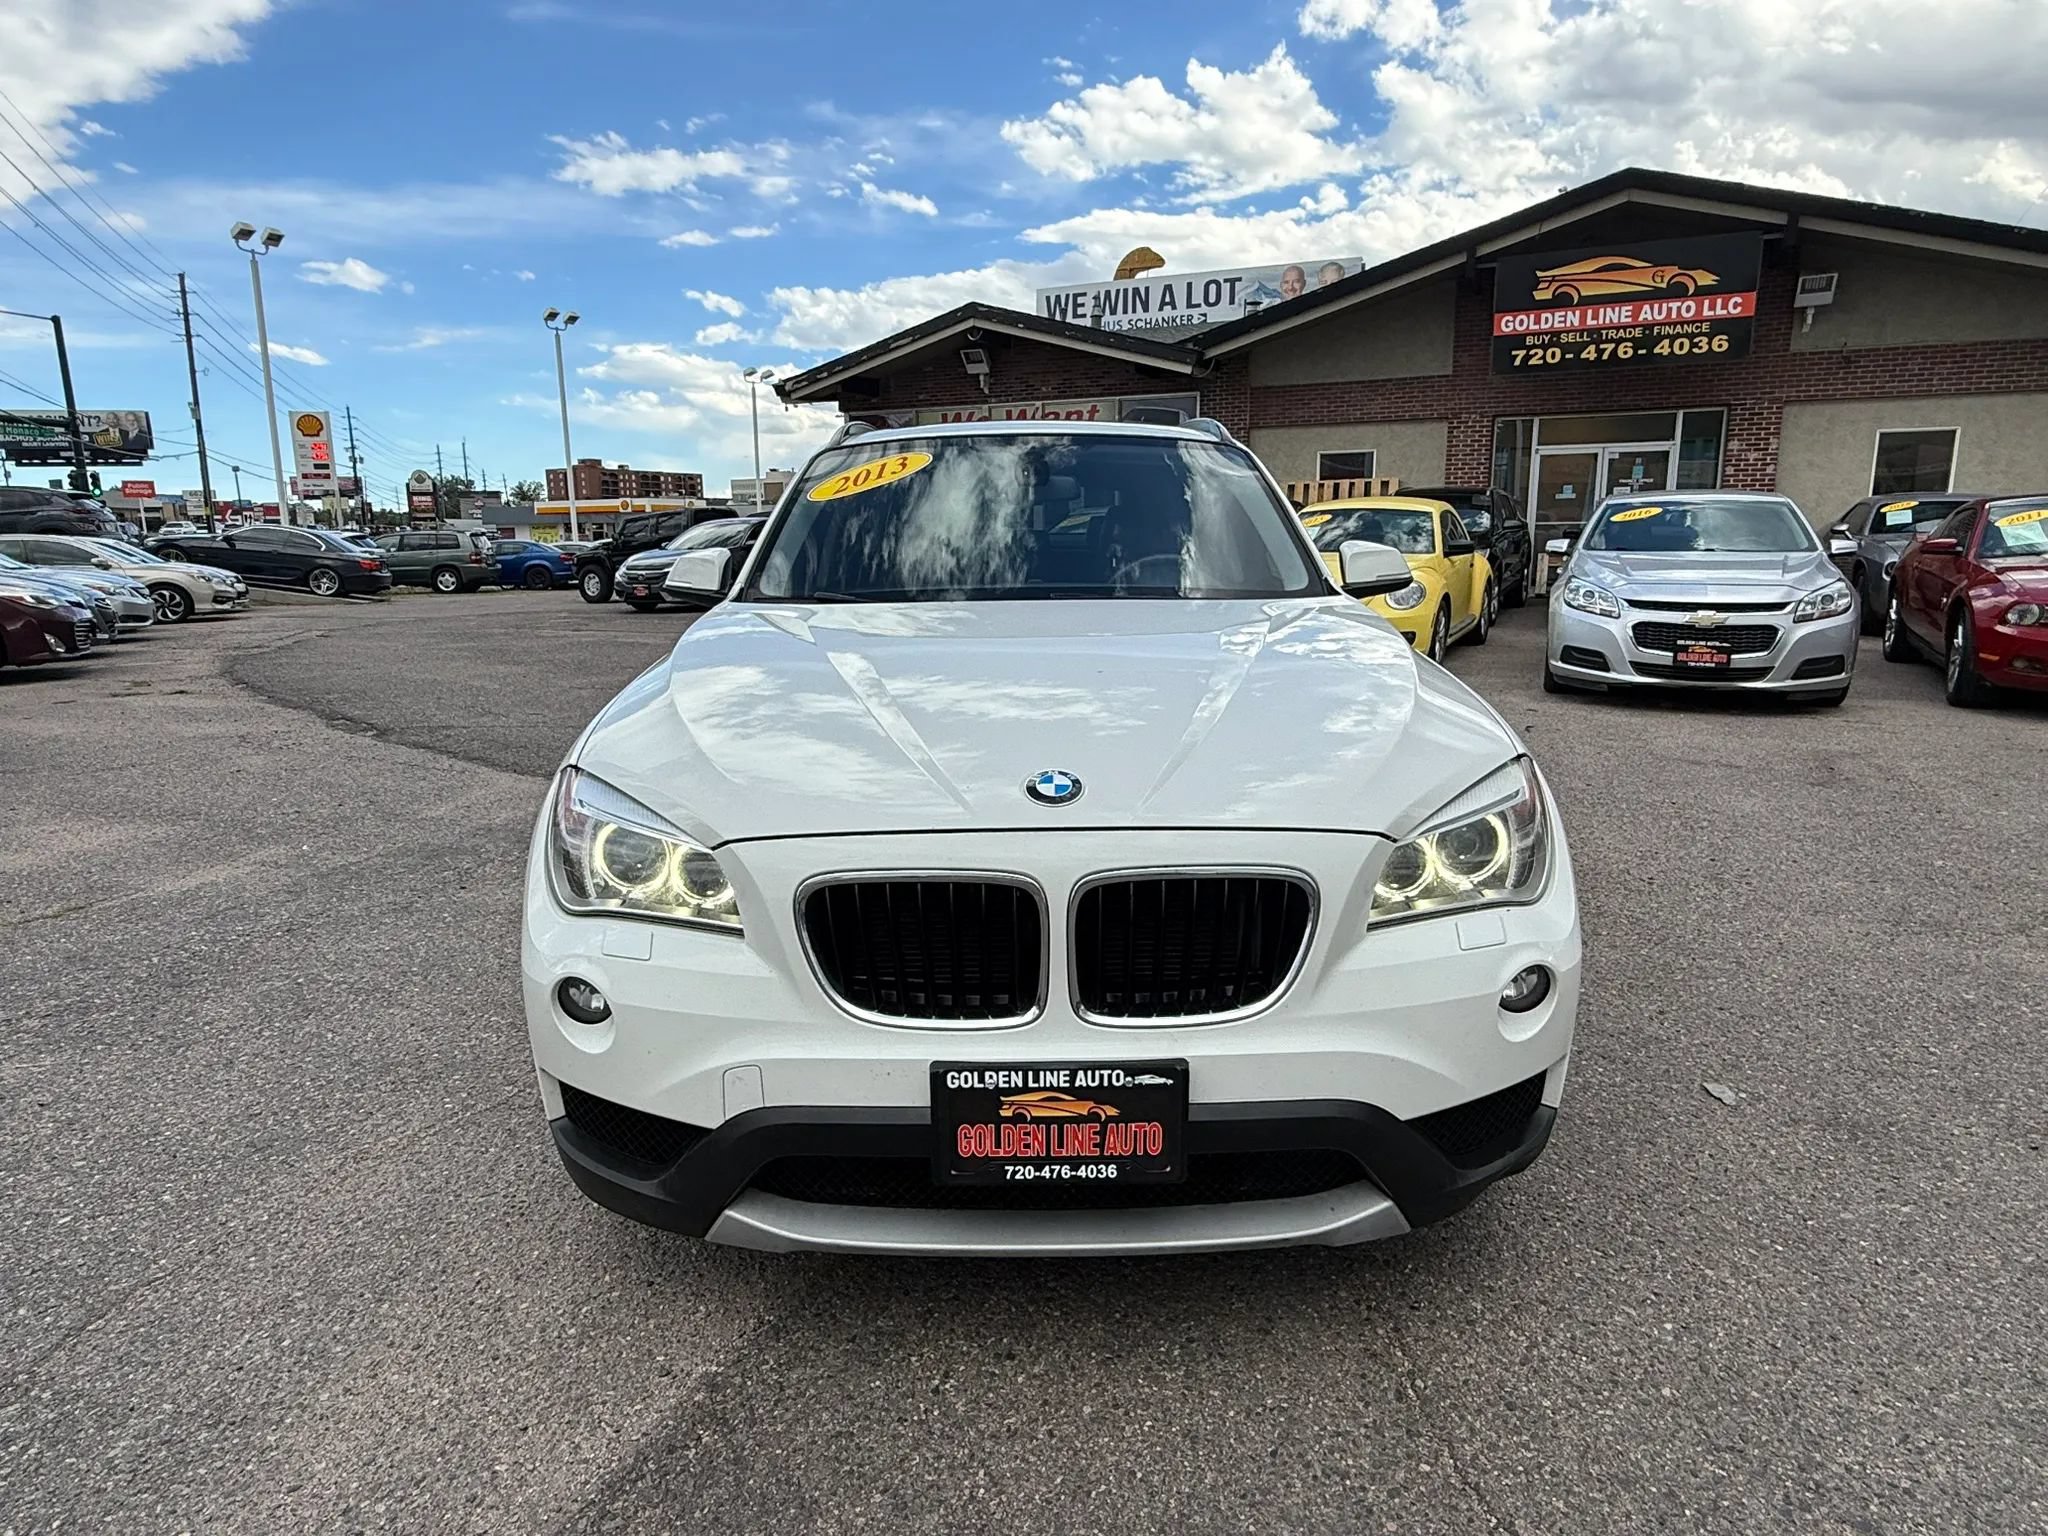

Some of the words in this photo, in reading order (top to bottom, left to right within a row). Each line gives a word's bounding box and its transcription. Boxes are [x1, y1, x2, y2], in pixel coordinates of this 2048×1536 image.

[1045, 291, 1088, 321] WE
[1097, 283, 1150, 317] WIN
[1157, 281, 1178, 311] A
[1185, 276, 1243, 310] LOT
[1127, 313, 1194, 330] SCHANKER
[1500, 311, 1581, 332] GOLDEN
[1586, 305, 1633, 326] LINE
[1638, 301, 1696, 321] AUTO
[1702, 296, 1743, 316] LLC
[1525, 334, 1551, 346] BUY
[1560, 332, 1591, 344] SELL
[1601, 328, 1643, 340] TRADE
[1653, 322, 1711, 337] FINANCE
[6, 426, 40, 436] Monaco
[832, 456, 909, 496] 2013
[2006, 511, 2042, 525] 2011
[946, 1070, 1023, 1089] GOLDEN
[1027, 1069, 1070, 1088] LINE
[1074, 1069, 1124, 1088] AUTO
[957, 1123, 1047, 1158] GOLDEN
[1050, 1122, 1100, 1157] LINE
[1103, 1121, 1163, 1157] AUTO
[1004, 1164, 1118, 1180] 720-476-4036
